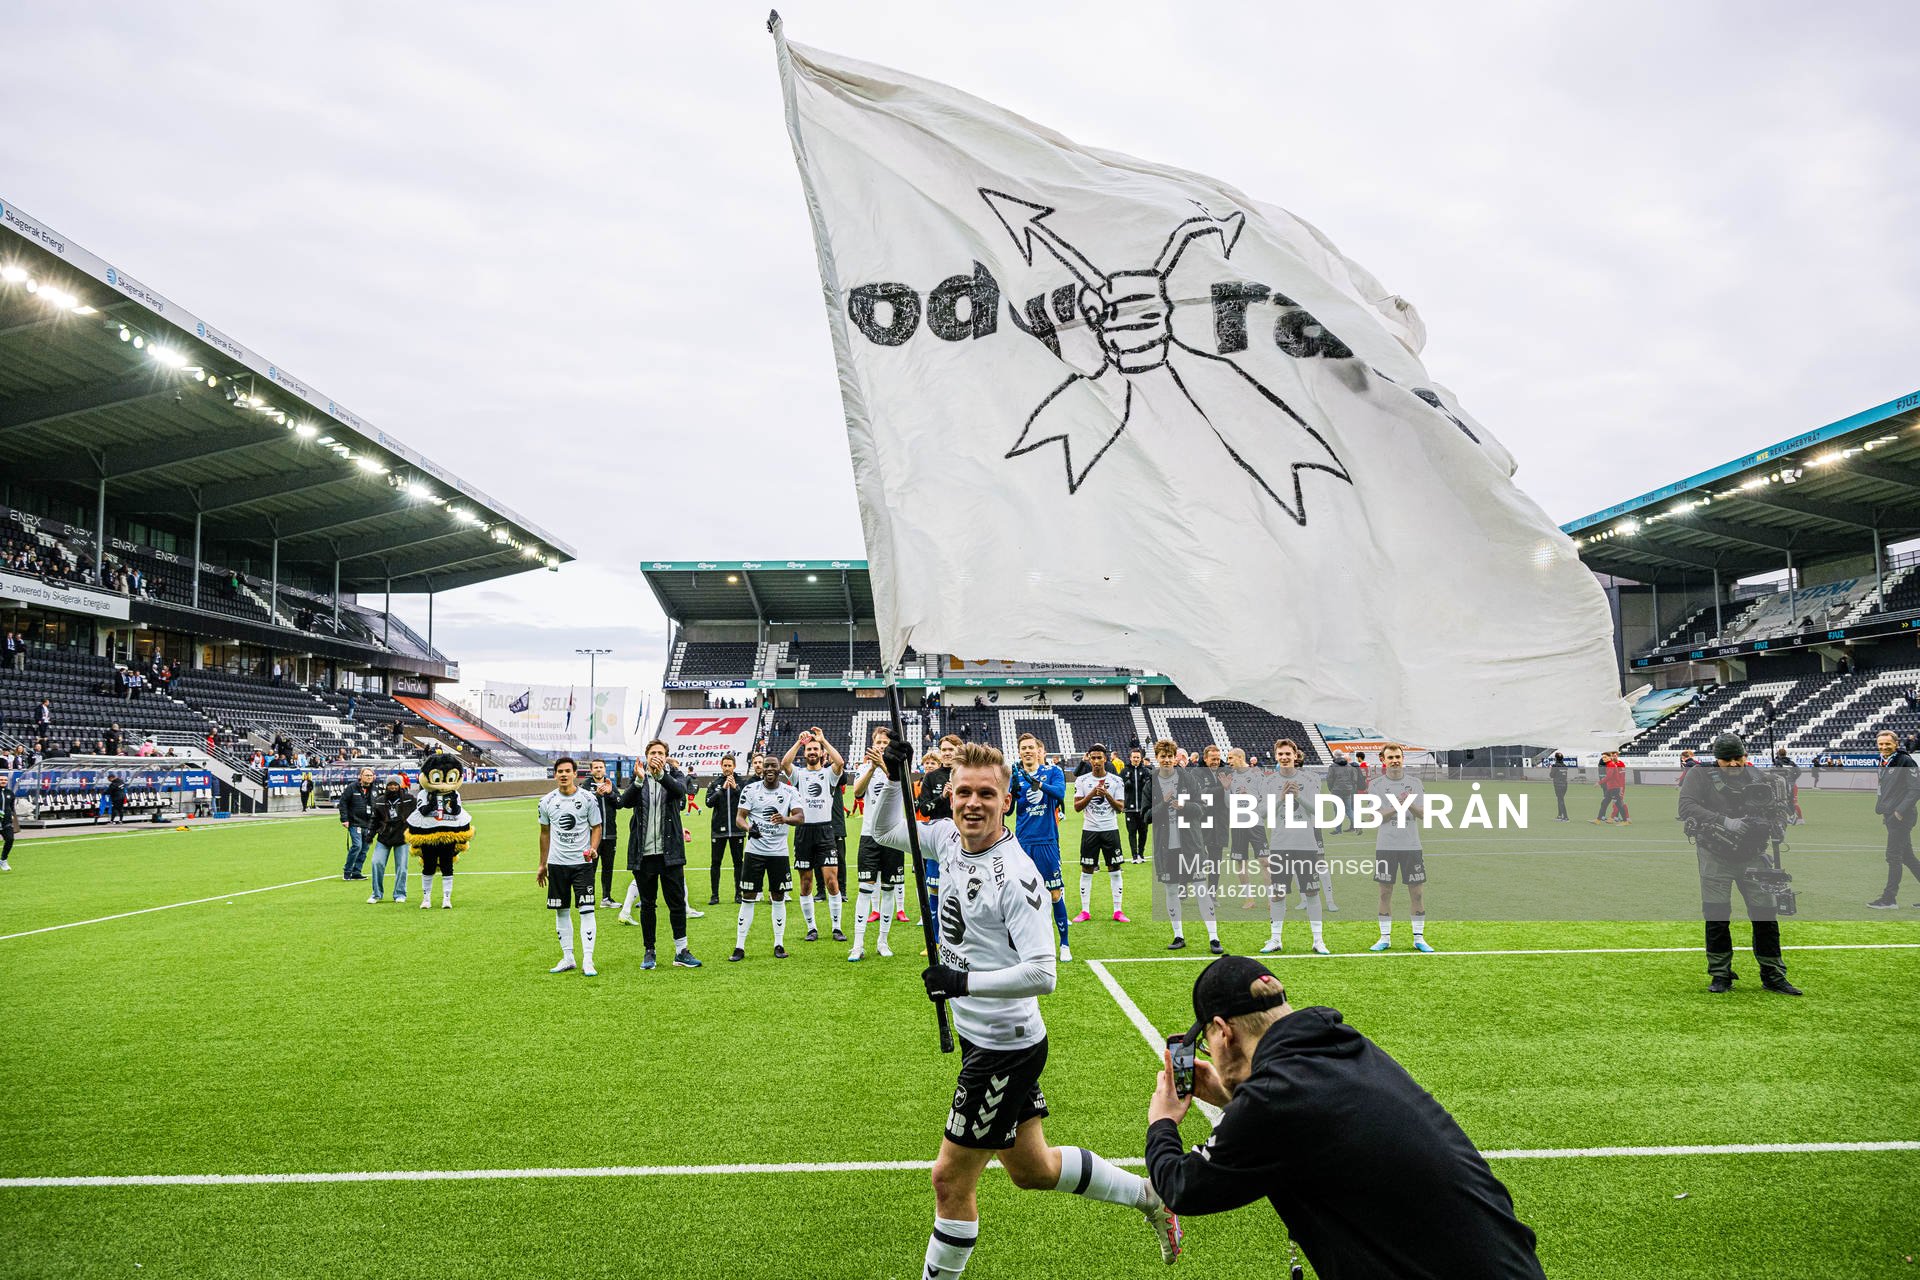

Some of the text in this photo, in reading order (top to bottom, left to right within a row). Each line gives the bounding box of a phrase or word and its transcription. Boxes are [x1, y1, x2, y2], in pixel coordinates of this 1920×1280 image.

[5, 210, 65, 253] Skagerak Energi
[117, 276, 145, 300] Skagerak
[1896, 394, 1919, 411] FJUZ
[1756, 451, 1769, 462] NYE
[10, 509, 41, 527] ENRX
[111, 537, 138, 553] ENRX
[155, 549, 178, 564] ENRX
[199, 562, 216, 574] NRX
[12, 584, 41, 597] powered
[43, 590, 50, 600] by
[52, 591, 81, 605] Skagerak
[1691, 650, 1704, 659] FJUZ
[1754, 641, 1769, 651] FJUZ
[1828, 630, 1845, 640] FJUZ
[398, 677, 422, 693] ENRX
[664, 680, 745, 688] KONTORBYGG.no
[672, 717, 750, 736] TA
[699, 743, 730, 751] beste
[795, 860, 810, 868] ABB
[1081, 857, 1094, 865] ABB
[1044, 879, 1061, 887] ABB
[1409, 873, 1425, 882] ABB
[739, 881, 754, 890] ABB
[579, 895, 594, 904] ABB
[940, 944, 970, 972] agerak
